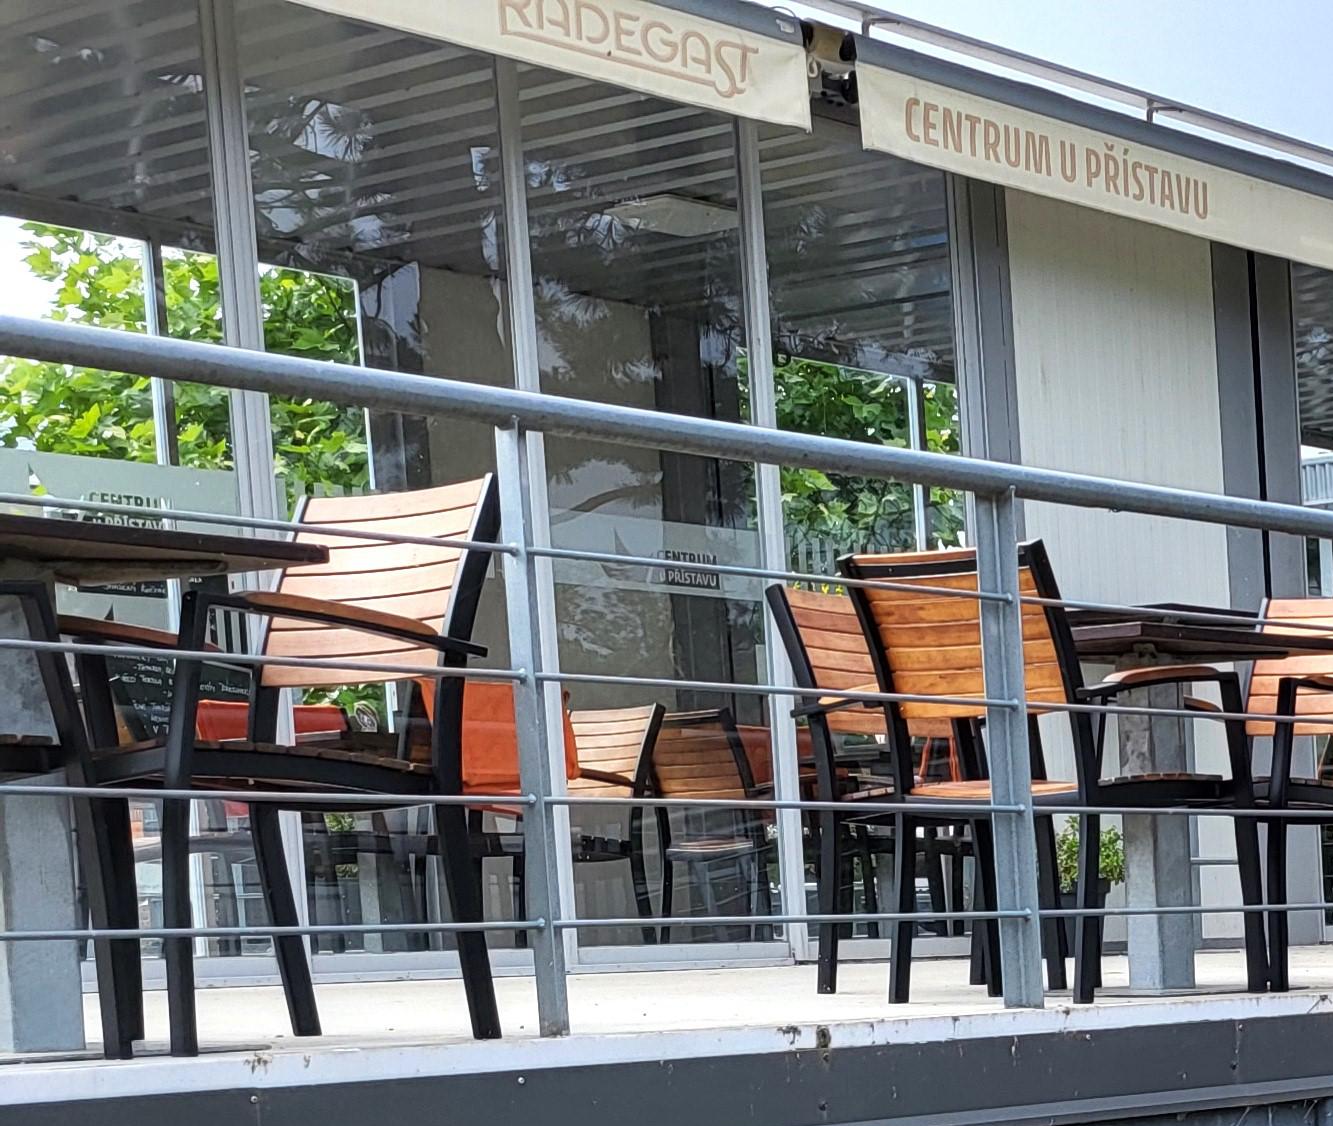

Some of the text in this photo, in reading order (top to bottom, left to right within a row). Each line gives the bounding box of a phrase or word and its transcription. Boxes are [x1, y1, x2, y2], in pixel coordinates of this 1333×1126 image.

[500, 0, 759, 98] RADEGAST
[905, 97, 1209, 220] CENTRUM U PŘÍSTAVU
